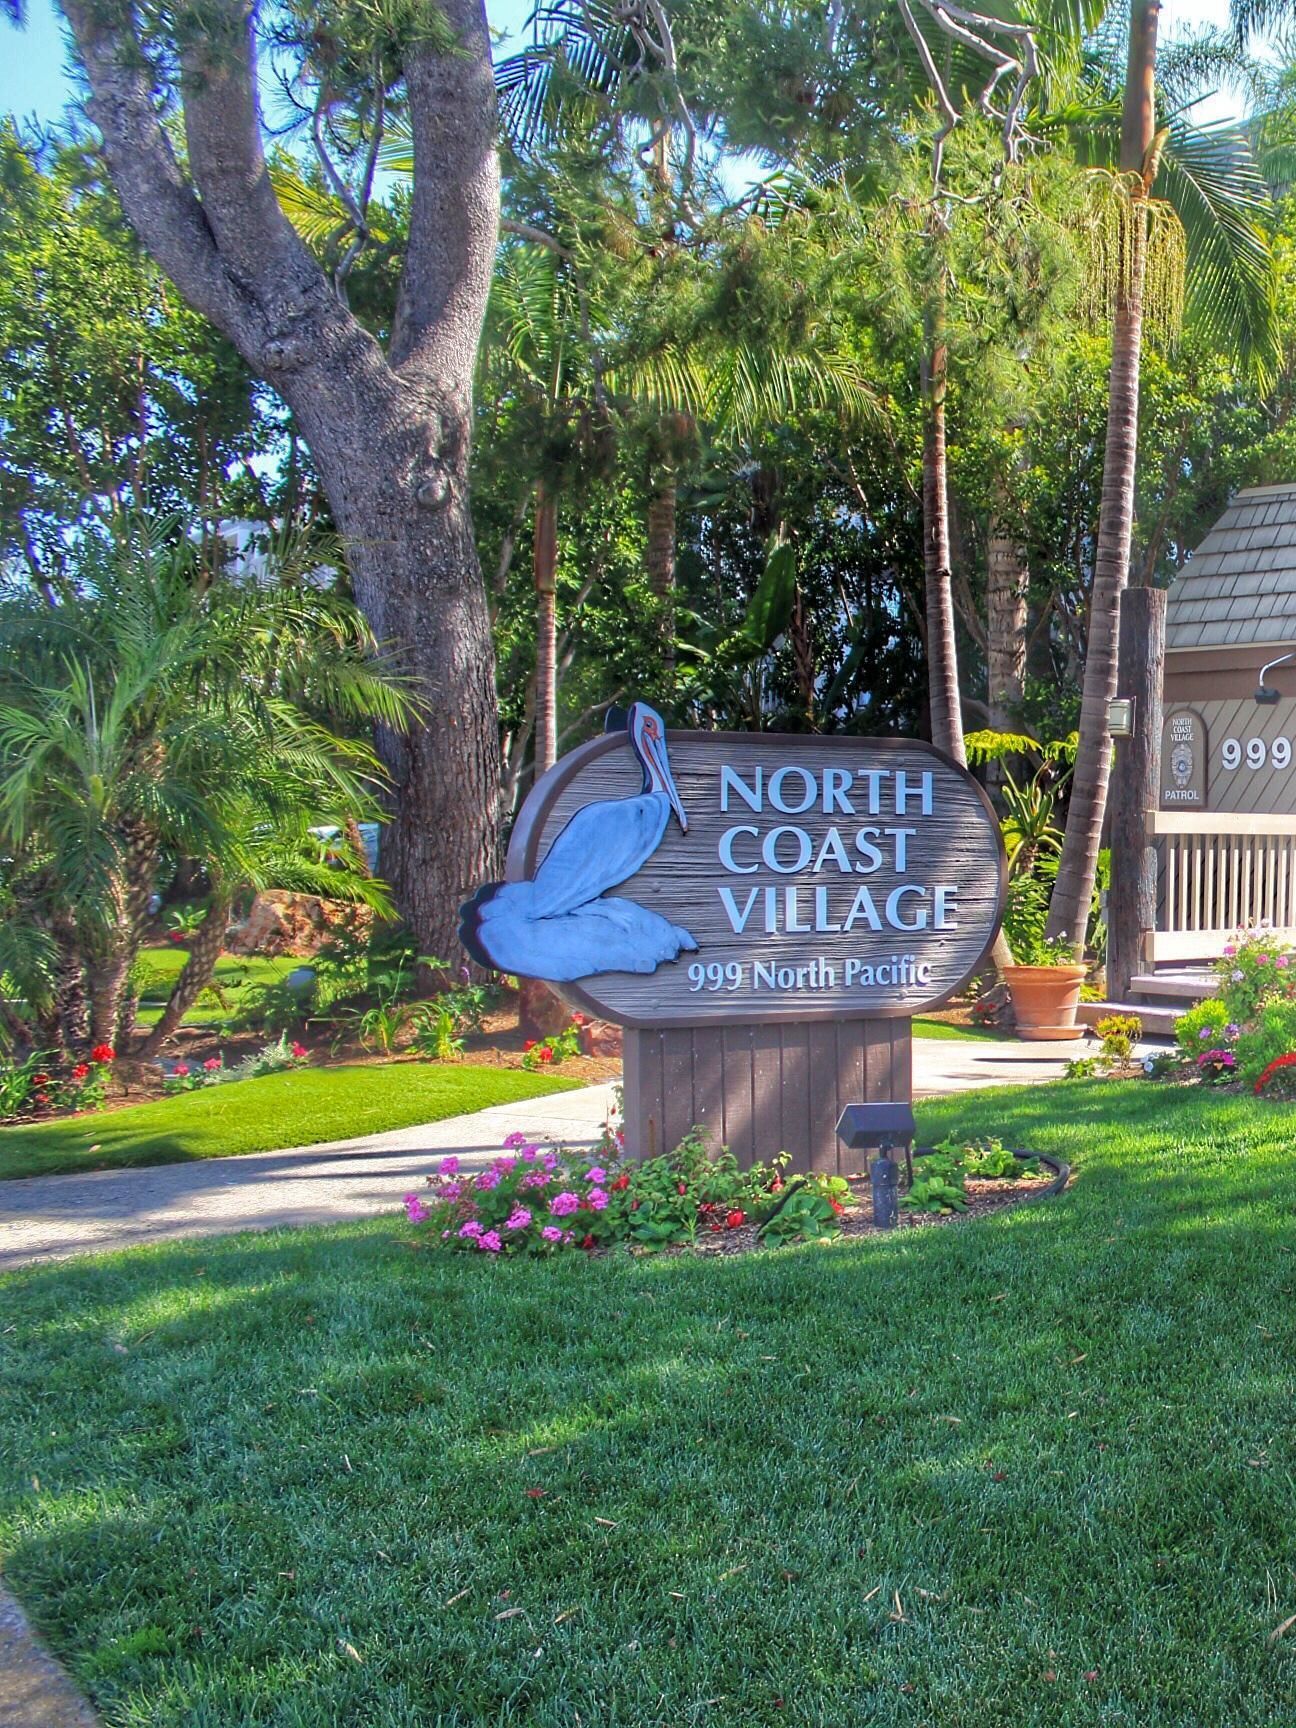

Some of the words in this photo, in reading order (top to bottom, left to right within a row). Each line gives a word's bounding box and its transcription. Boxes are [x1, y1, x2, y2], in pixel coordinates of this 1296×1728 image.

[1170, 733, 1195, 742] VILLAGE
[1172, 717, 1193, 727] NORTH
[1173, 725, 1192, 734] COAST
[1222, 737, 1292, 770] 999
[720, 765, 933, 816] NORTH
[1164, 790, 1200, 800] PATROL
[718, 825, 917, 874] COAST
[717, 885, 958, 934] VILLAGE
[687, 963, 743, 992] 999
[753, 957, 835, 990] North
[845, 954, 932, 988] Pacific
